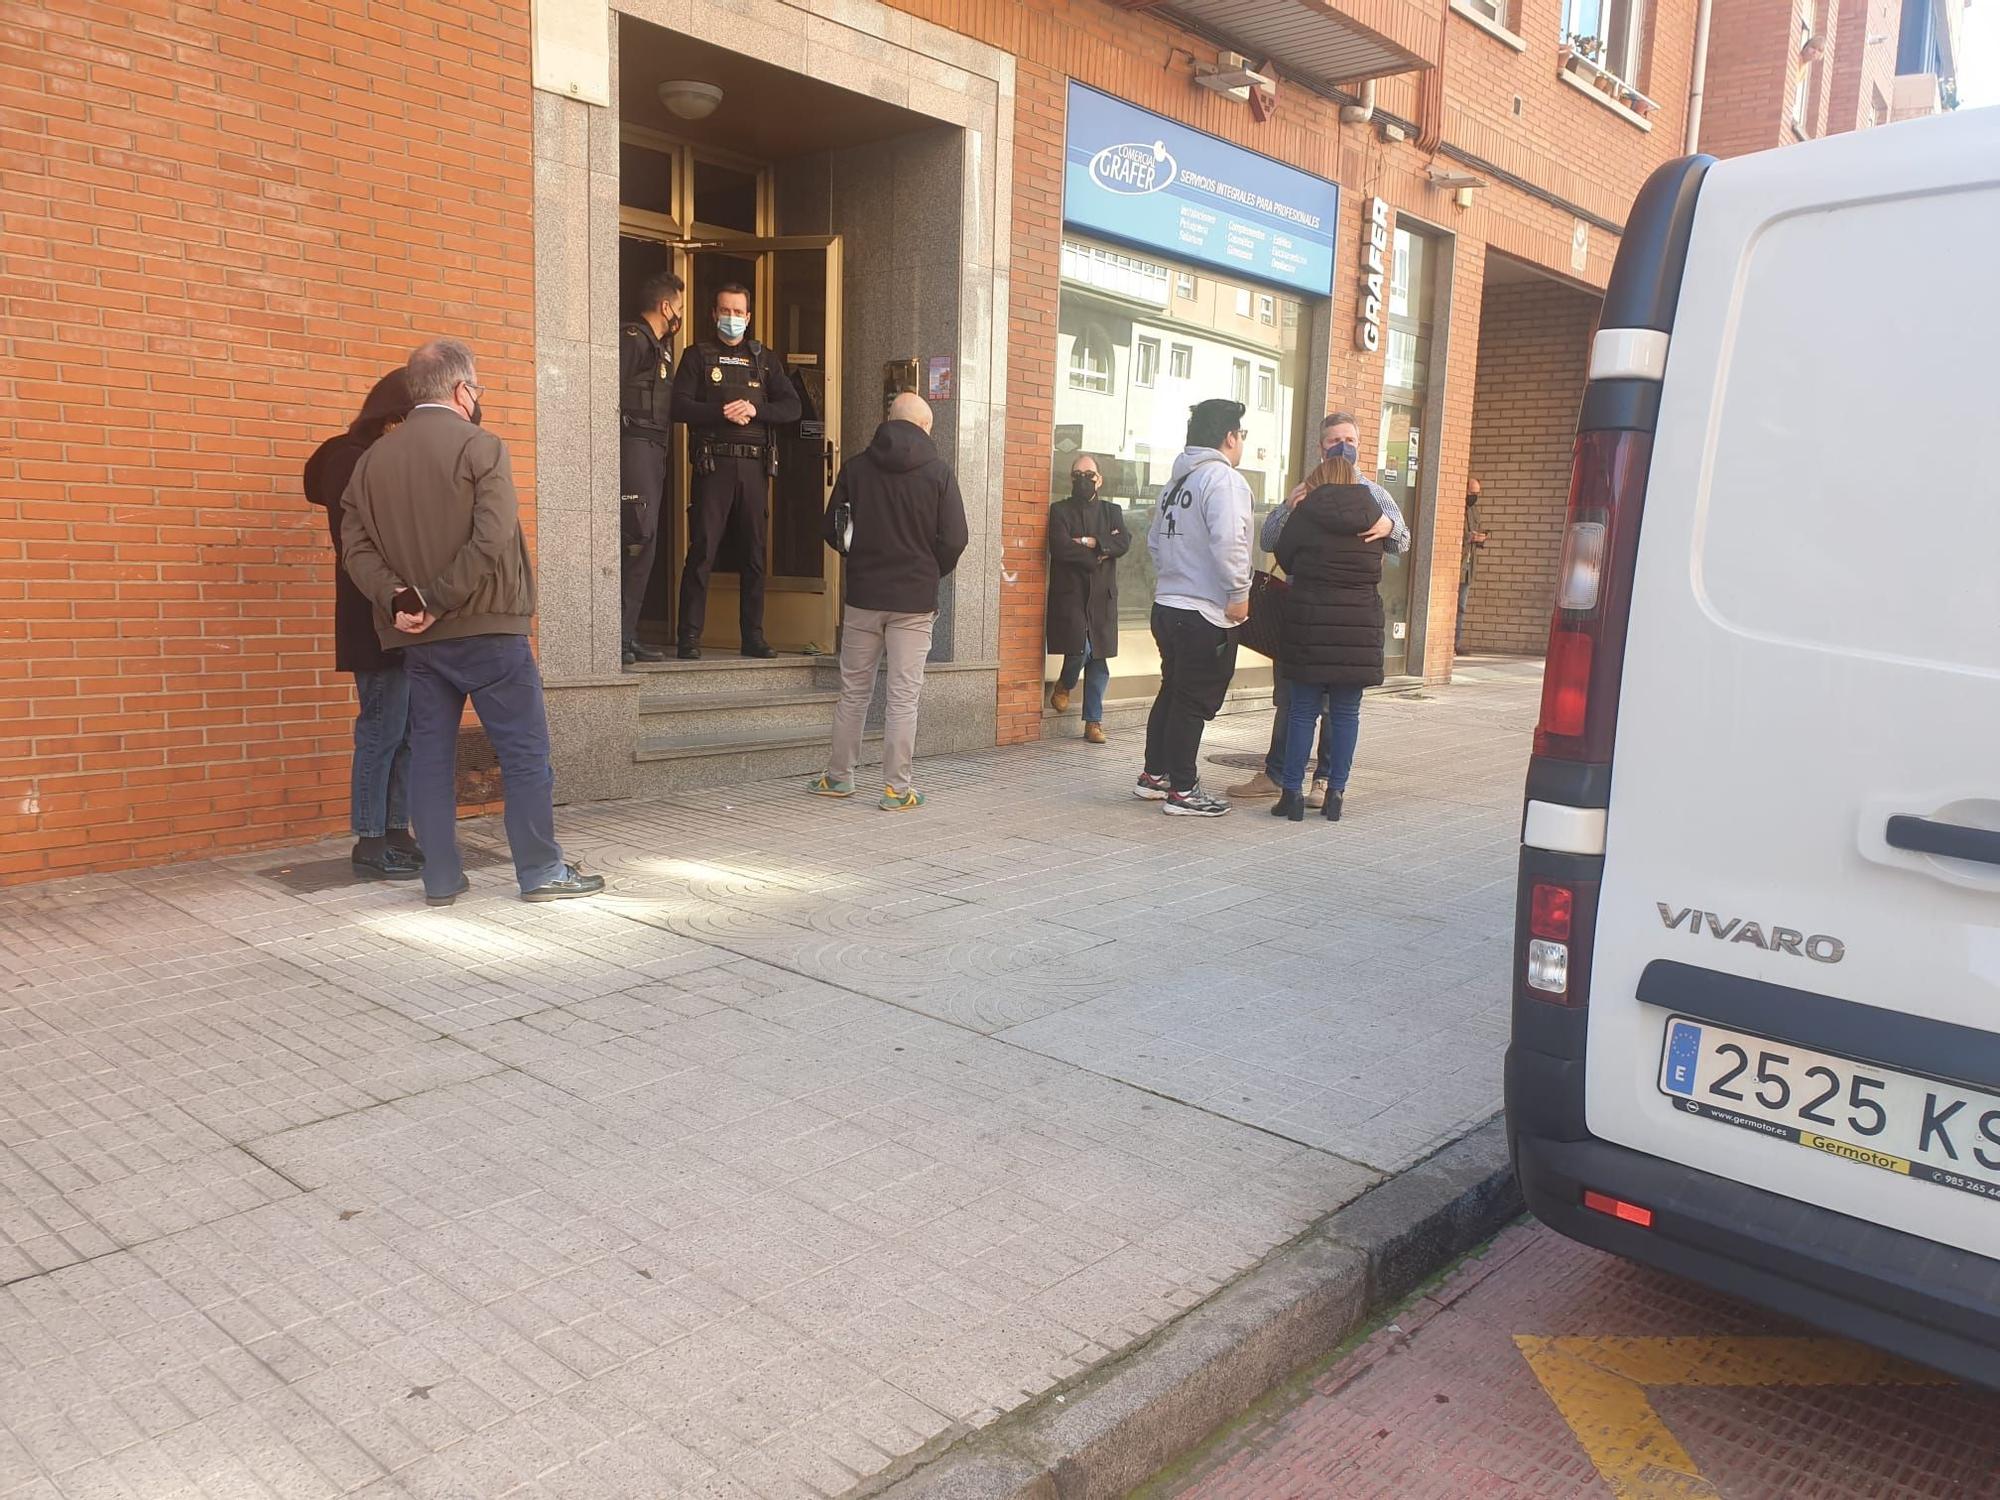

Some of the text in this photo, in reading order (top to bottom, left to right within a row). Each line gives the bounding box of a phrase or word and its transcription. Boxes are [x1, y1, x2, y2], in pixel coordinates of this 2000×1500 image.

[1100, 152, 1156, 191] GRAFER
[1118, 145, 1156, 168] COMERCIAL
[1180, 169, 1320, 229] SERVICIOS INTEGRALES PARA PROFESIONALES
[1363, 196, 1389, 352] GRAFER
[1656, 902, 1846, 964] VIVARO
[1675, 1064, 1687, 1083] E
[1708, 1043, 1887, 1136] 2525
[1711, 1109, 1788, 1136] www.germotor.es
[1811, 1135, 1898, 1170] Germotor
[1945, 1174, 1964, 1188] 985
[1966, 1180, 1986, 1194] 265
